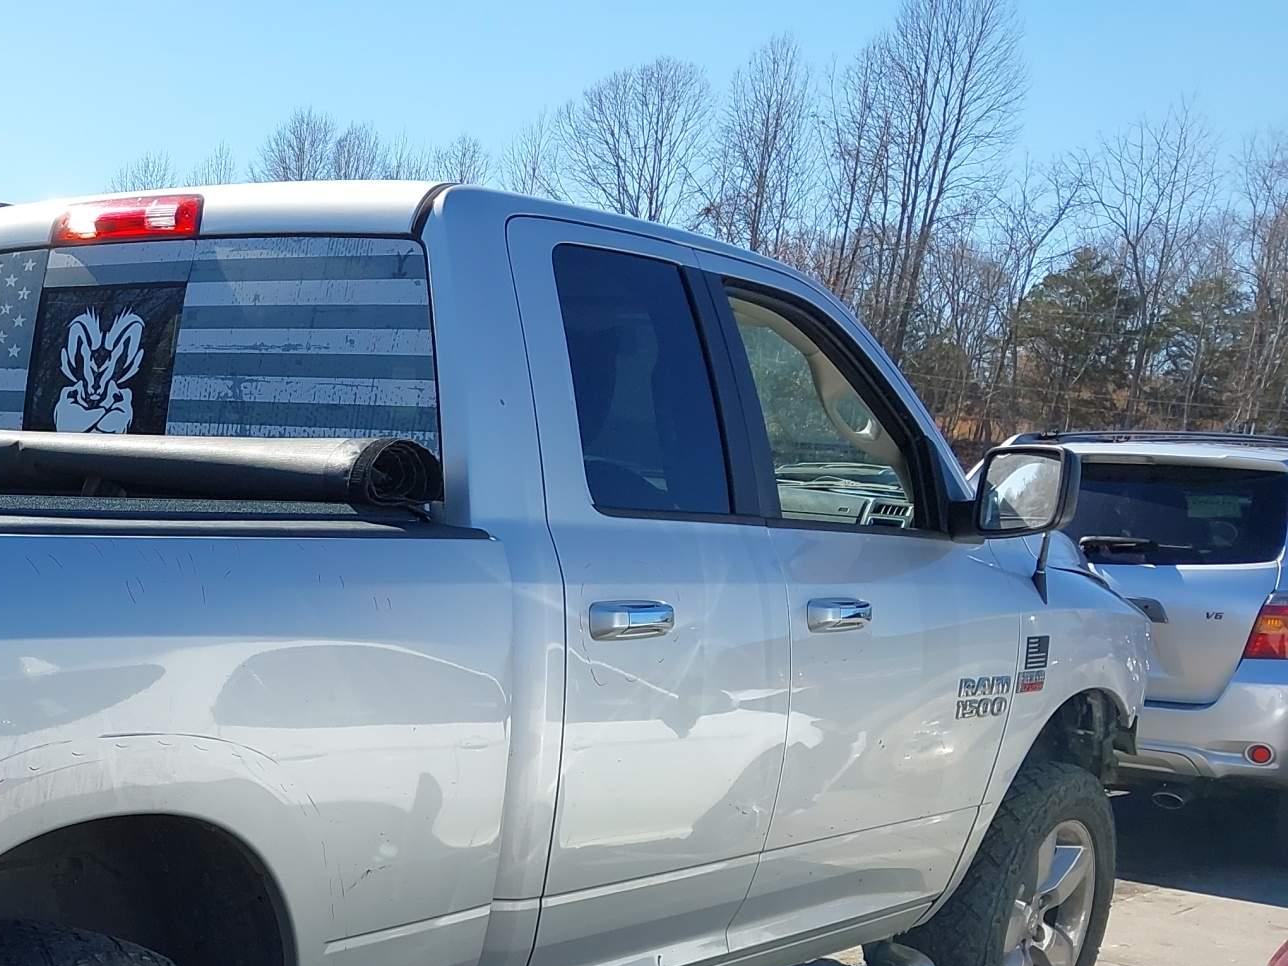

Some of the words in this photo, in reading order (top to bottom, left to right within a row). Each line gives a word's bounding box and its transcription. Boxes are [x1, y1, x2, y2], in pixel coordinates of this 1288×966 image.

[1205, 611, 1224, 620] V6
[959, 676, 1011, 698] RAM
[956, 697, 1007, 719] 1500
